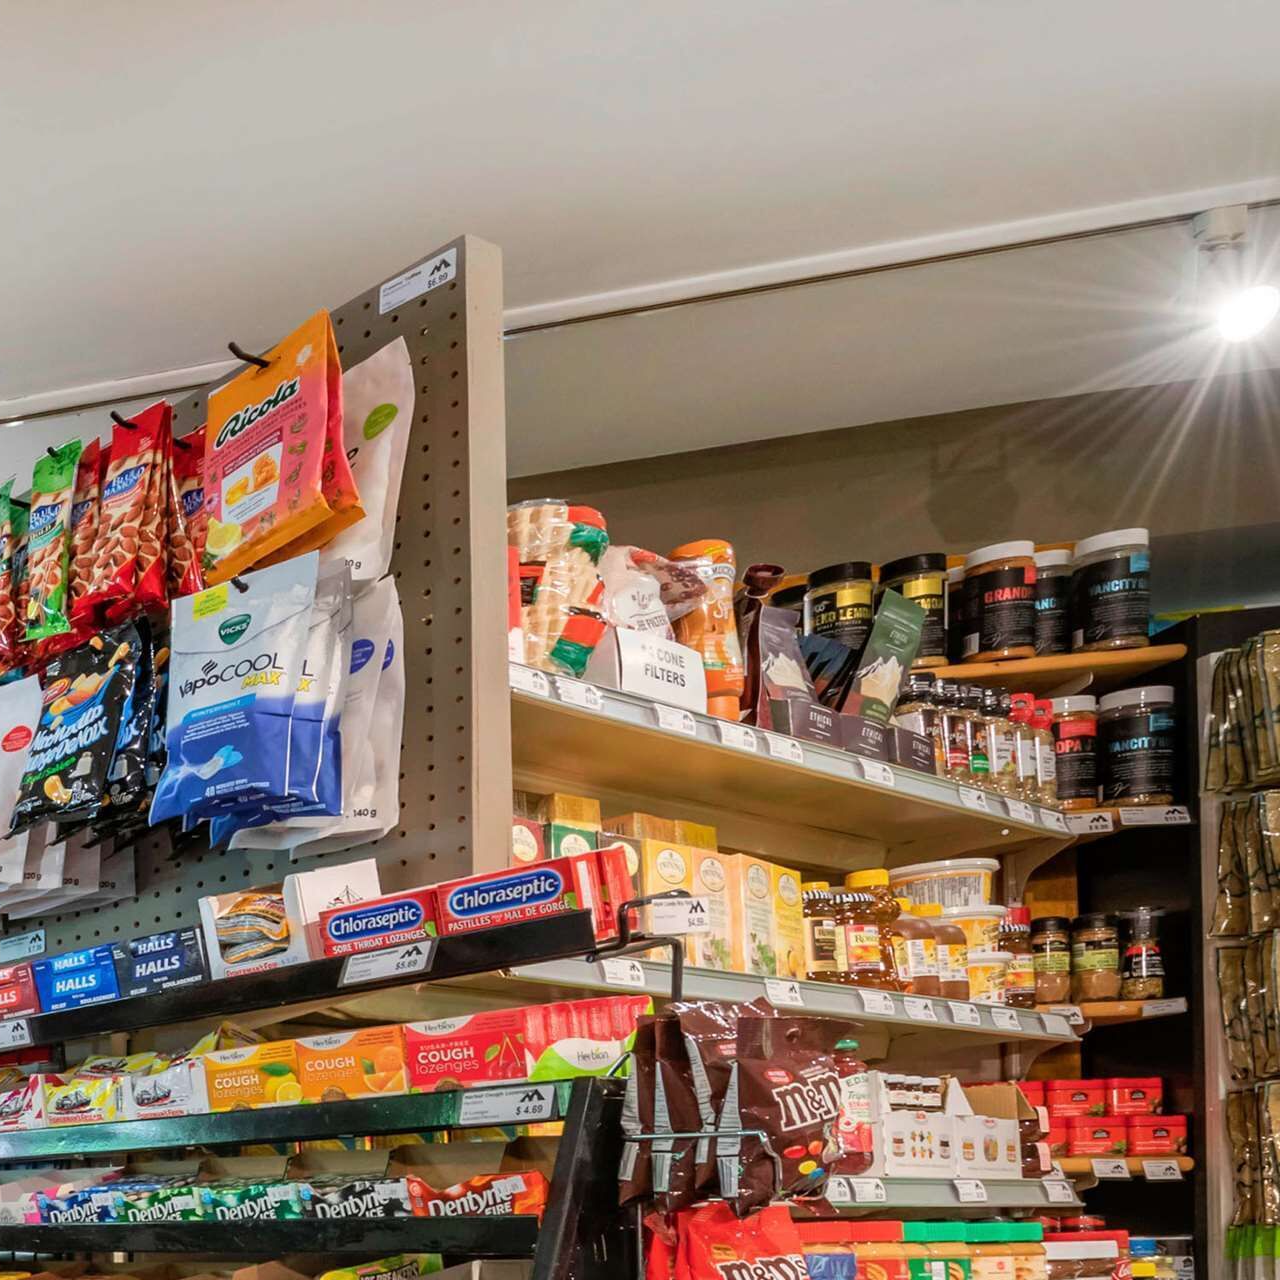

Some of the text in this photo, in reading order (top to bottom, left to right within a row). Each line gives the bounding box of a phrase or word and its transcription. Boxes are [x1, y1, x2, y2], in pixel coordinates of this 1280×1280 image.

[215, 378, 301, 447] Ricola
[220, 622, 248, 636] VICKS
[656, 647, 686, 669] CONE
[179, 652, 284, 698] VapoCOOL
[242, 671, 282, 690] MAX
[644, 665, 687, 687] FILTERS
[452, 875, 556, 910] Chloraseptic
[332, 905, 418, 937] Chloraseptic
[447, 898, 572, 931] PASTILLES MAL DE GORGE
[138, 937, 174, 955] HALLS
[332, 929, 427, 954] SORE THROAT LOZENGES
[54, 955, 86, 970] HALLS
[135, 955, 180, 977] HALLS
[55, 975, 97, 993] HALLS
[423, 1021, 456, 1033] Herbion
[417, 1047, 476, 1064] COUGH
[420, 1041, 470, 1052] SUGAR-FREE
[576, 1047, 611, 1063] Herbion
[305, 1056, 356, 1073] COUGH
[416, 1057, 480, 1075] lozenges
[213, 1083, 266, 1100] lozenges
[214, 1074, 260, 1090] COUGH
[127, 1196, 186, 1221] Dentyne
[427, 1187, 513, 1217] Dentyne FIRE
[50, 1200, 102, 1225] Dentyne
